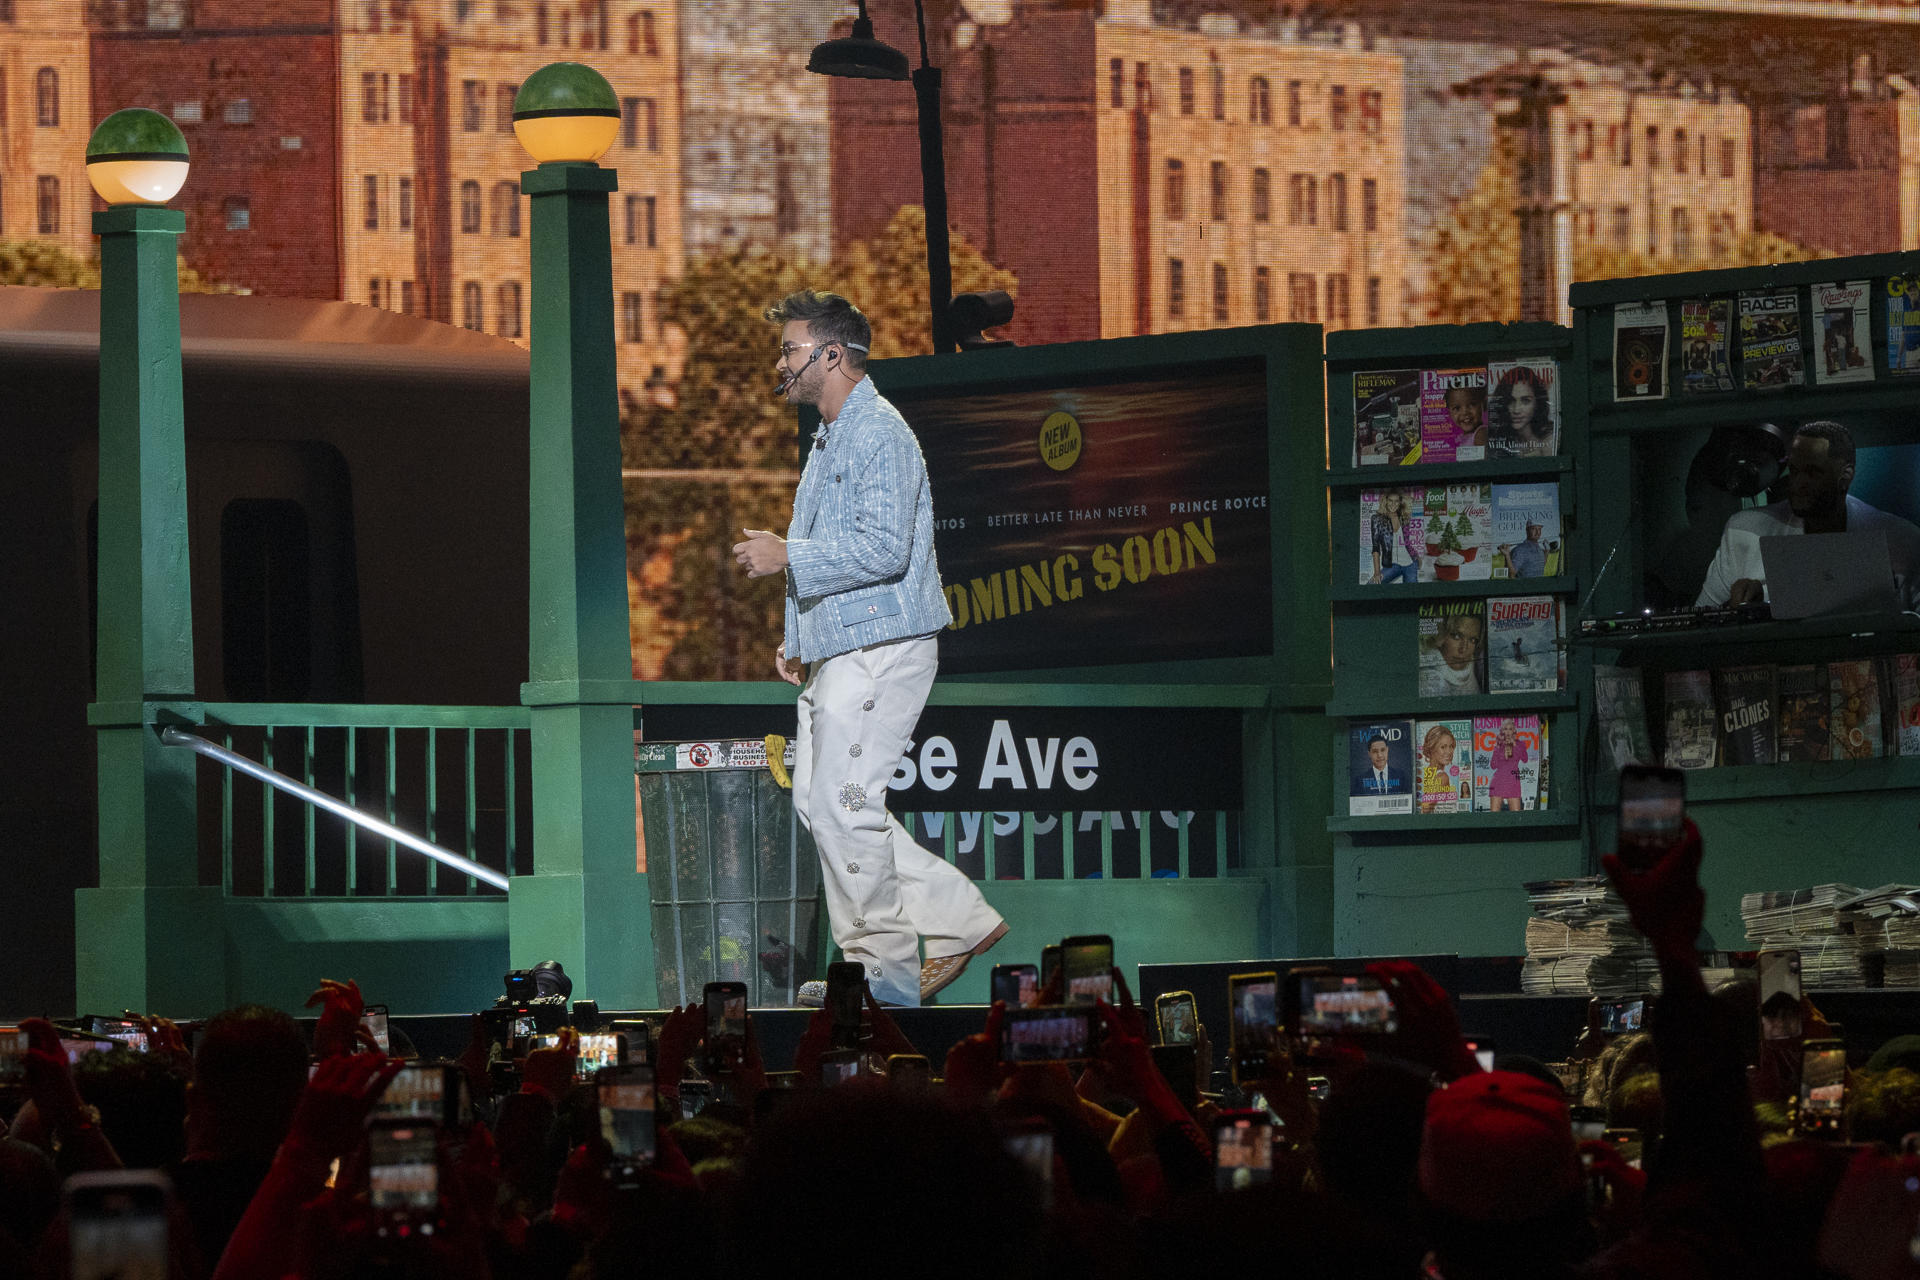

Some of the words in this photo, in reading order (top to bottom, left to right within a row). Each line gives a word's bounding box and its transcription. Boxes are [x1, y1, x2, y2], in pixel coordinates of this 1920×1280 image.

[1740, 296, 1798, 313] RACER
[1743, 344, 1787, 360] PREVIEW
[1358, 379, 1396, 388] RIFLEMAN
[1423, 371, 1486, 390] Parents
[1044, 421, 1071, 448] NEW
[1048, 437, 1078, 462] ALBUM
[1489, 440, 1505, 449] Wild
[1426, 490, 1446, 506] food
[934, 517, 966, 530] NTOS
[987, 512, 1029, 527] BETTER
[1034, 510, 1063, 524] LATE
[1068, 508, 1100, 521] THAN
[1107, 504, 1148, 519] NEVER
[1169, 498, 1218, 514] PRINCE
[1224, 495, 1267, 510] ROYCE
[1499, 511, 1553, 522] BREAKING
[942, 552, 1084, 631] OMING
[1091, 516, 1216, 592] SOON
[1724, 699, 1770, 733] CLONES
[1449, 723, 1470, 731] STYLE
[978, 719, 1099, 791] Ave
